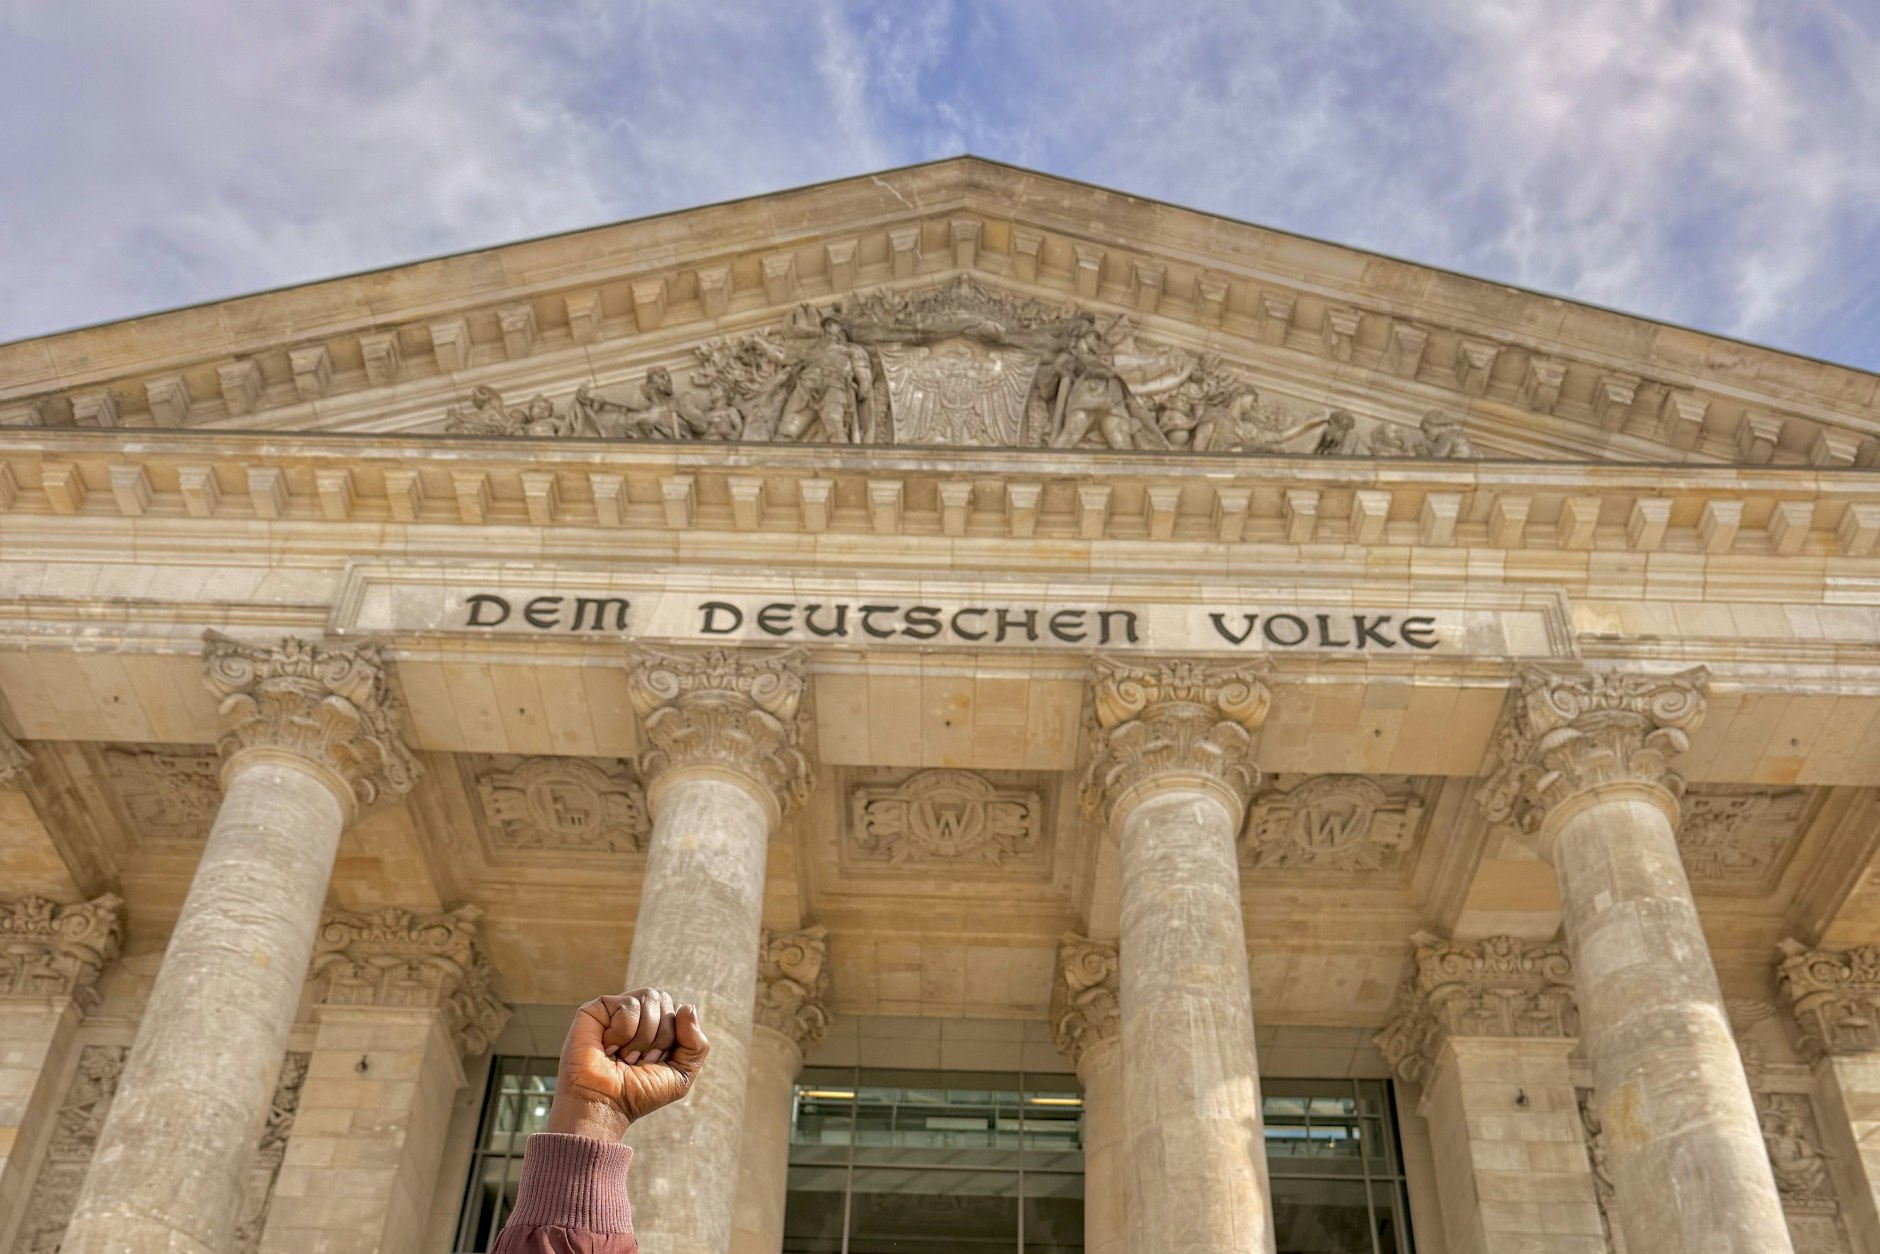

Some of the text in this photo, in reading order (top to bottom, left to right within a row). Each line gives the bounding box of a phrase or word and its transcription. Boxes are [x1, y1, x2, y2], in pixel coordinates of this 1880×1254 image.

[465, 594, 1440, 649] DEM DEUTSCHEN VOLKE
